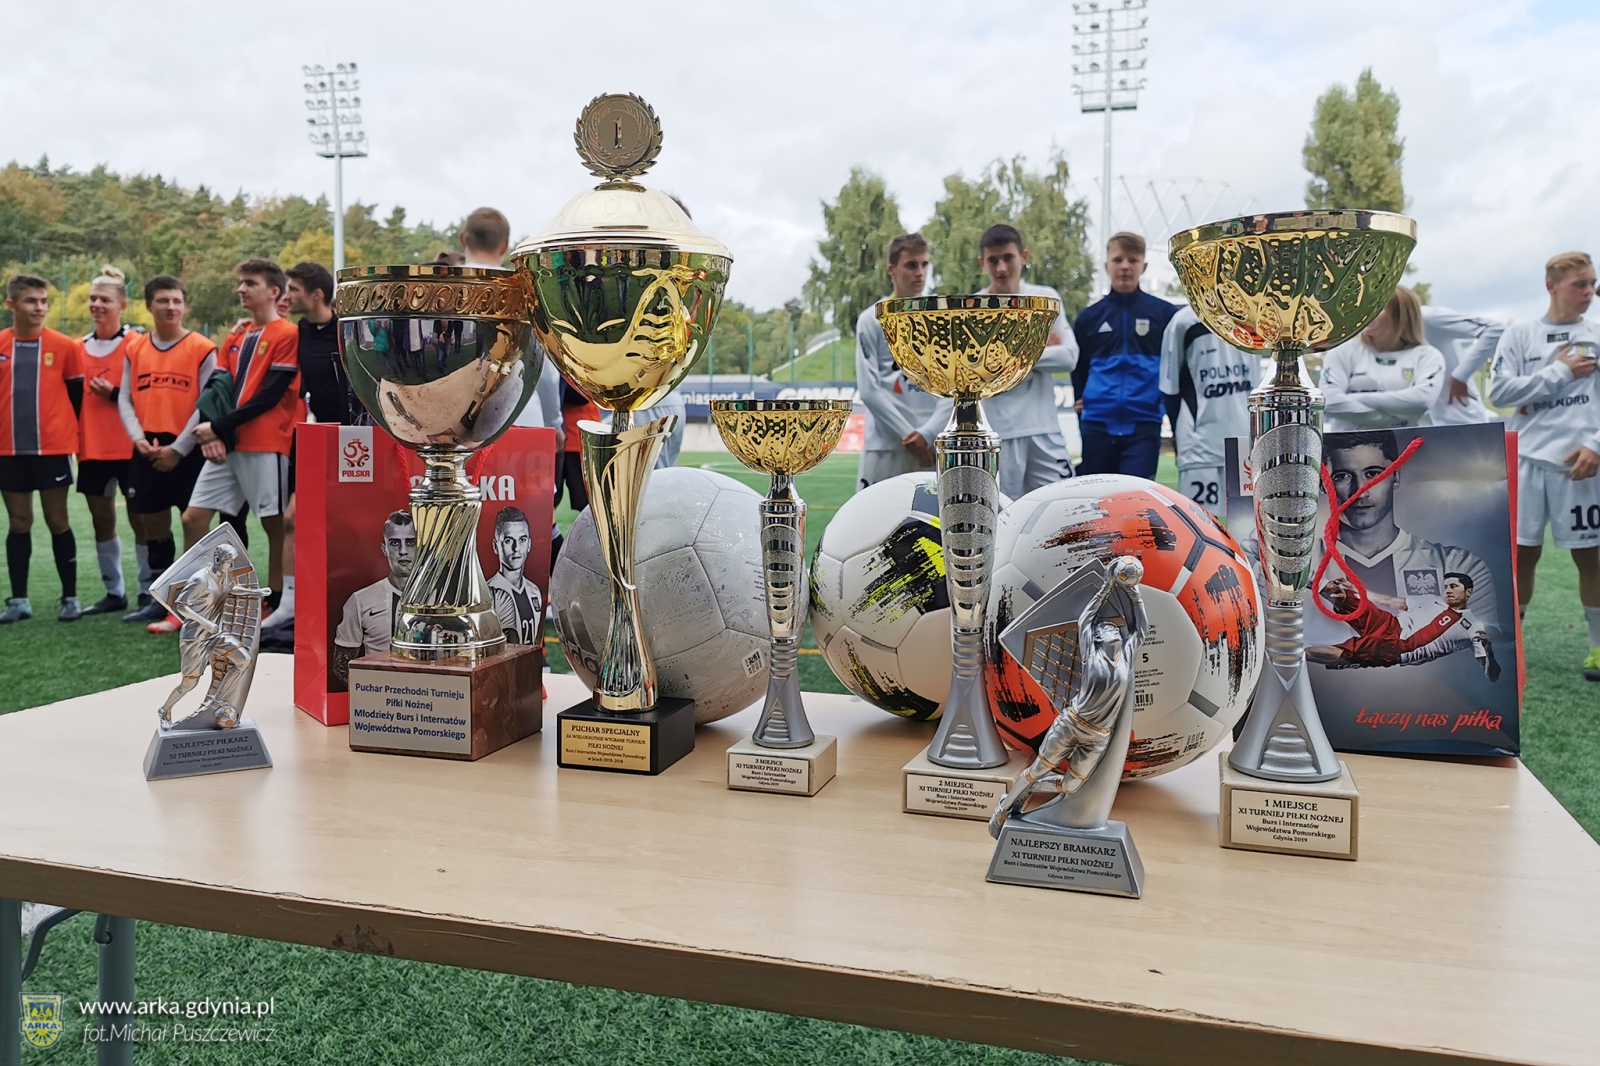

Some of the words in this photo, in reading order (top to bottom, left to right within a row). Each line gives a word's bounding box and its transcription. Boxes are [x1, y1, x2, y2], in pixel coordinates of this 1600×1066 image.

[613, 116, 624, 149] 1
[342, 470, 370, 478] POLSKA
[1190, 480, 1219, 505] 28
[1570, 504, 1600, 531] 10
[1438, 615, 1452, 626] 9
[522, 618, 536, 645] 21
[1142, 653, 1149, 663] 5
[355, 683, 382, 693] Puchar
[385, 685, 428, 696] Przechodni
[431, 689, 464, 700] Turnieju
[386, 699, 403, 707] Piłki
[405, 700, 433, 711] Nożnej
[355, 709, 394, 721] Młodzieży
[396, 713, 414, 721] Burs
[421, 714, 466, 725] Internatów
[1356, 706, 1412, 732] Łączy
[1415, 713, 1449, 728] nas
[1450, 709, 1503, 733] piłka
[355, 722, 411, 735] Województwa
[413, 727, 465, 740] Pomorskiego
[572, 725, 600, 733] PUCHAR
[602, 727, 640, 736] SPECJALNY
[173, 739, 215, 750] NAJLEPSZY
[216, 736, 249, 745] PIŁKARZ
[178, 750, 206, 758] TURNIEJ
[207, 748, 225, 756] PIŁKI
[225, 745, 252, 754] NOŻNEJ
[944, 781, 974, 789] MIEJSCE
[969, 790, 994, 798] NOŻNEJ
[925, 798, 957, 806] Województwa
[957, 801, 987, 809] Pomorskiego
[1272, 800, 1318, 811] MIEJSCE
[1249, 809, 1285, 818] TURNIEJ
[1286, 812, 1308, 820] PIŁKI
[1310, 814, 1344, 824] NOŻNEJ
[1246, 824, 1291, 835] Województwa
[1292, 829, 1336, 839] Pomorskiego
[1283, 820, 1319, 829] Internatów
[1010, 838, 1061, 850] NAJLEPSZY
[1063, 844, 1116, 857] BRAMKARZ
[1022, 852, 1055, 863] TURNIEJ
[1057, 856, 1079, 865] PIŁKI
[1081, 858, 1113, 869] NOŻNEJ
[1020, 862, 1048, 870] Internatów
[1050, 865, 1086, 874] Województwa
[1086, 869, 1121, 880] Pomorskiego
